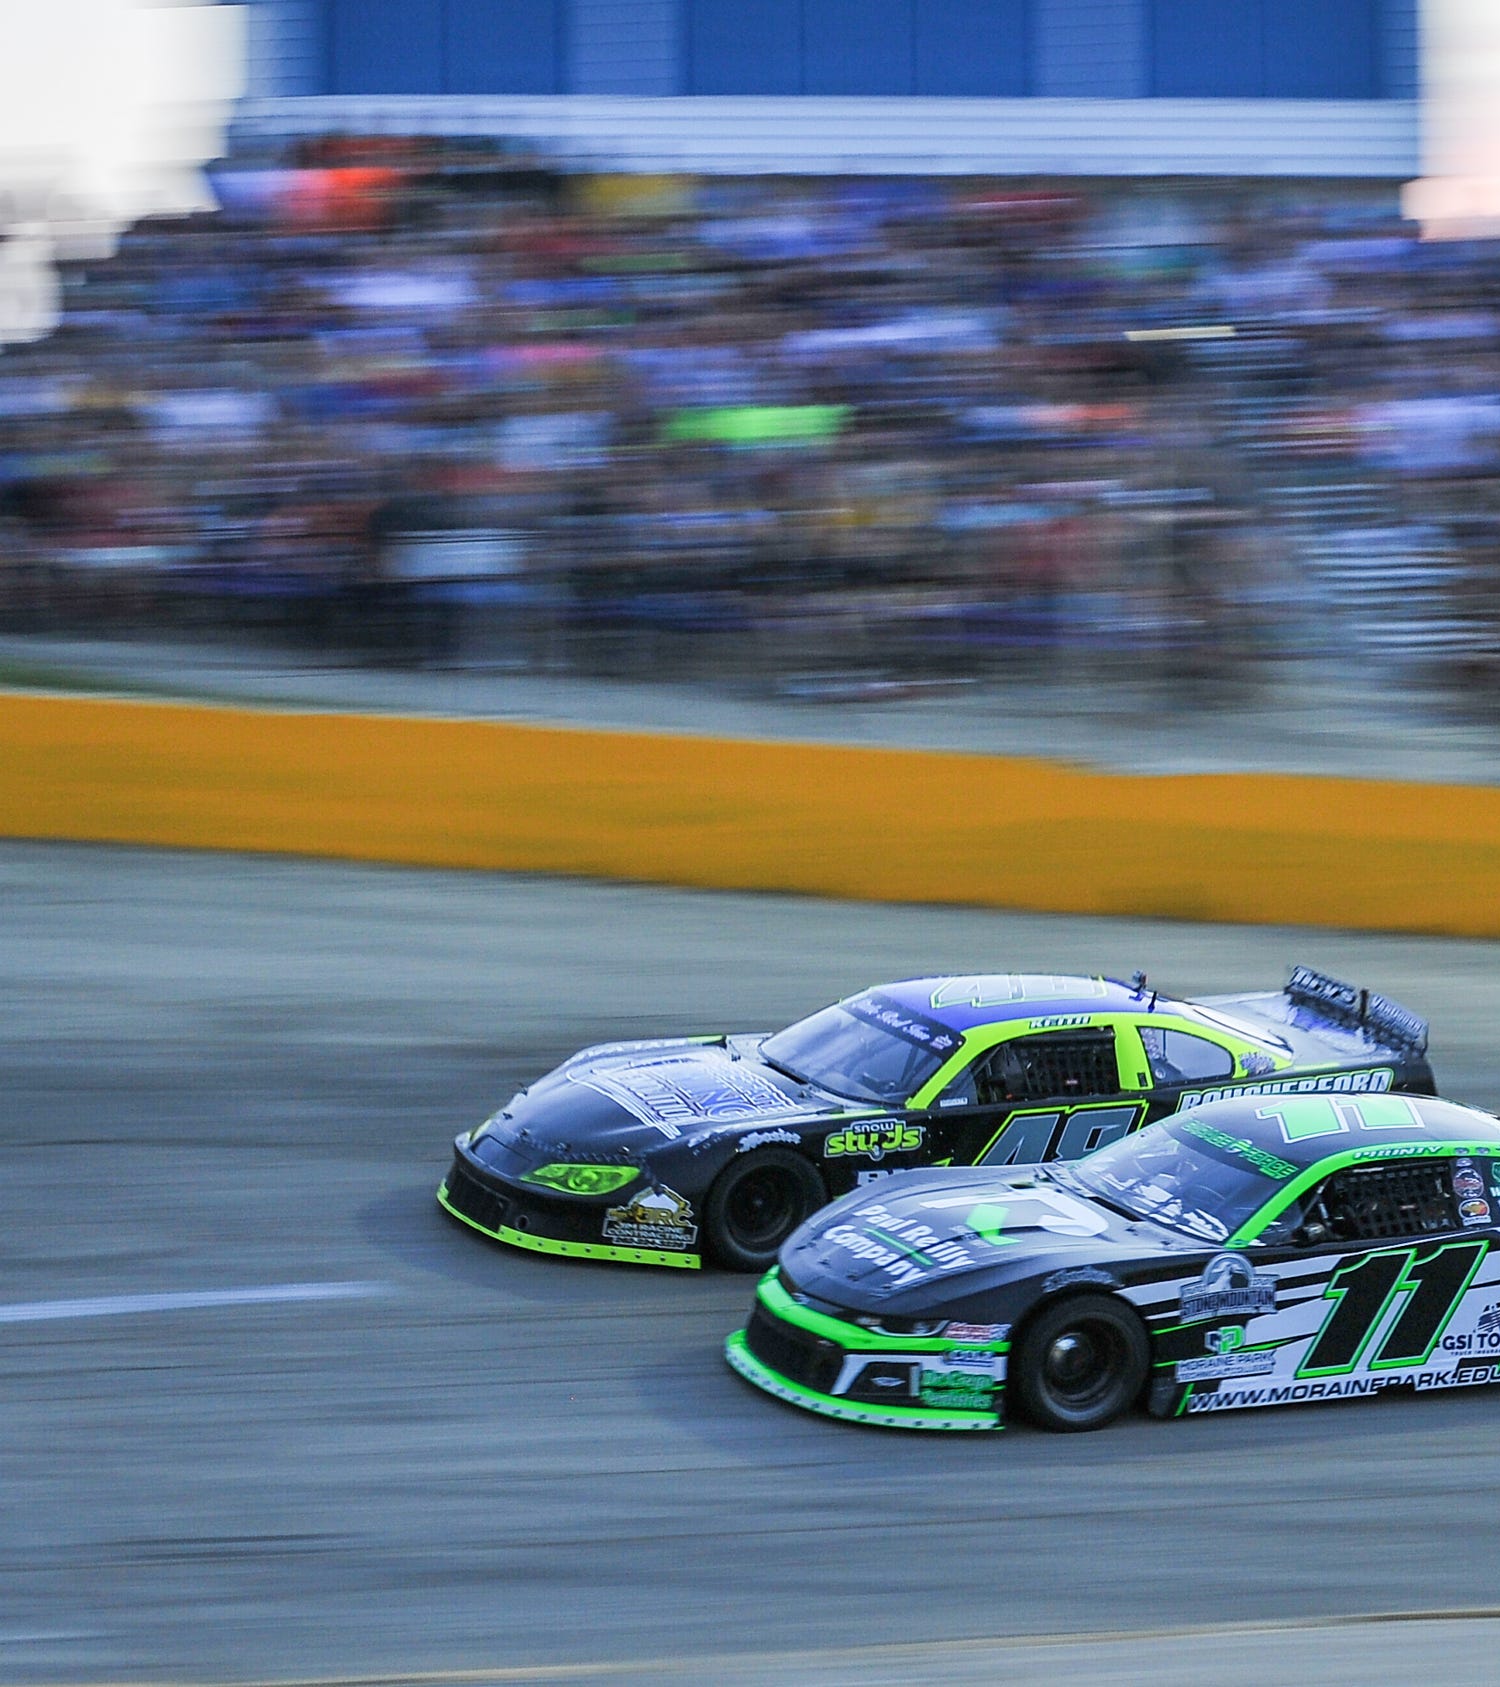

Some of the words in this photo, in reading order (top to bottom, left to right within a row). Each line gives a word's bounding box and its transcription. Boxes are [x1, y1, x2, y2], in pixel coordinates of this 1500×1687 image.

[827, 1124, 920, 1155] studs
[1256, 1095, 1425, 1144] 11
[1353, 1145, 1443, 1160] PRUNTY
[822, 1224, 928, 1285] Company
[852, 1204, 919, 1232] Paul
[897, 1225, 977, 1270] Reilly
[1294, 1239, 1490, 1379] 11
[1442, 1334, 1473, 1350] GSI
